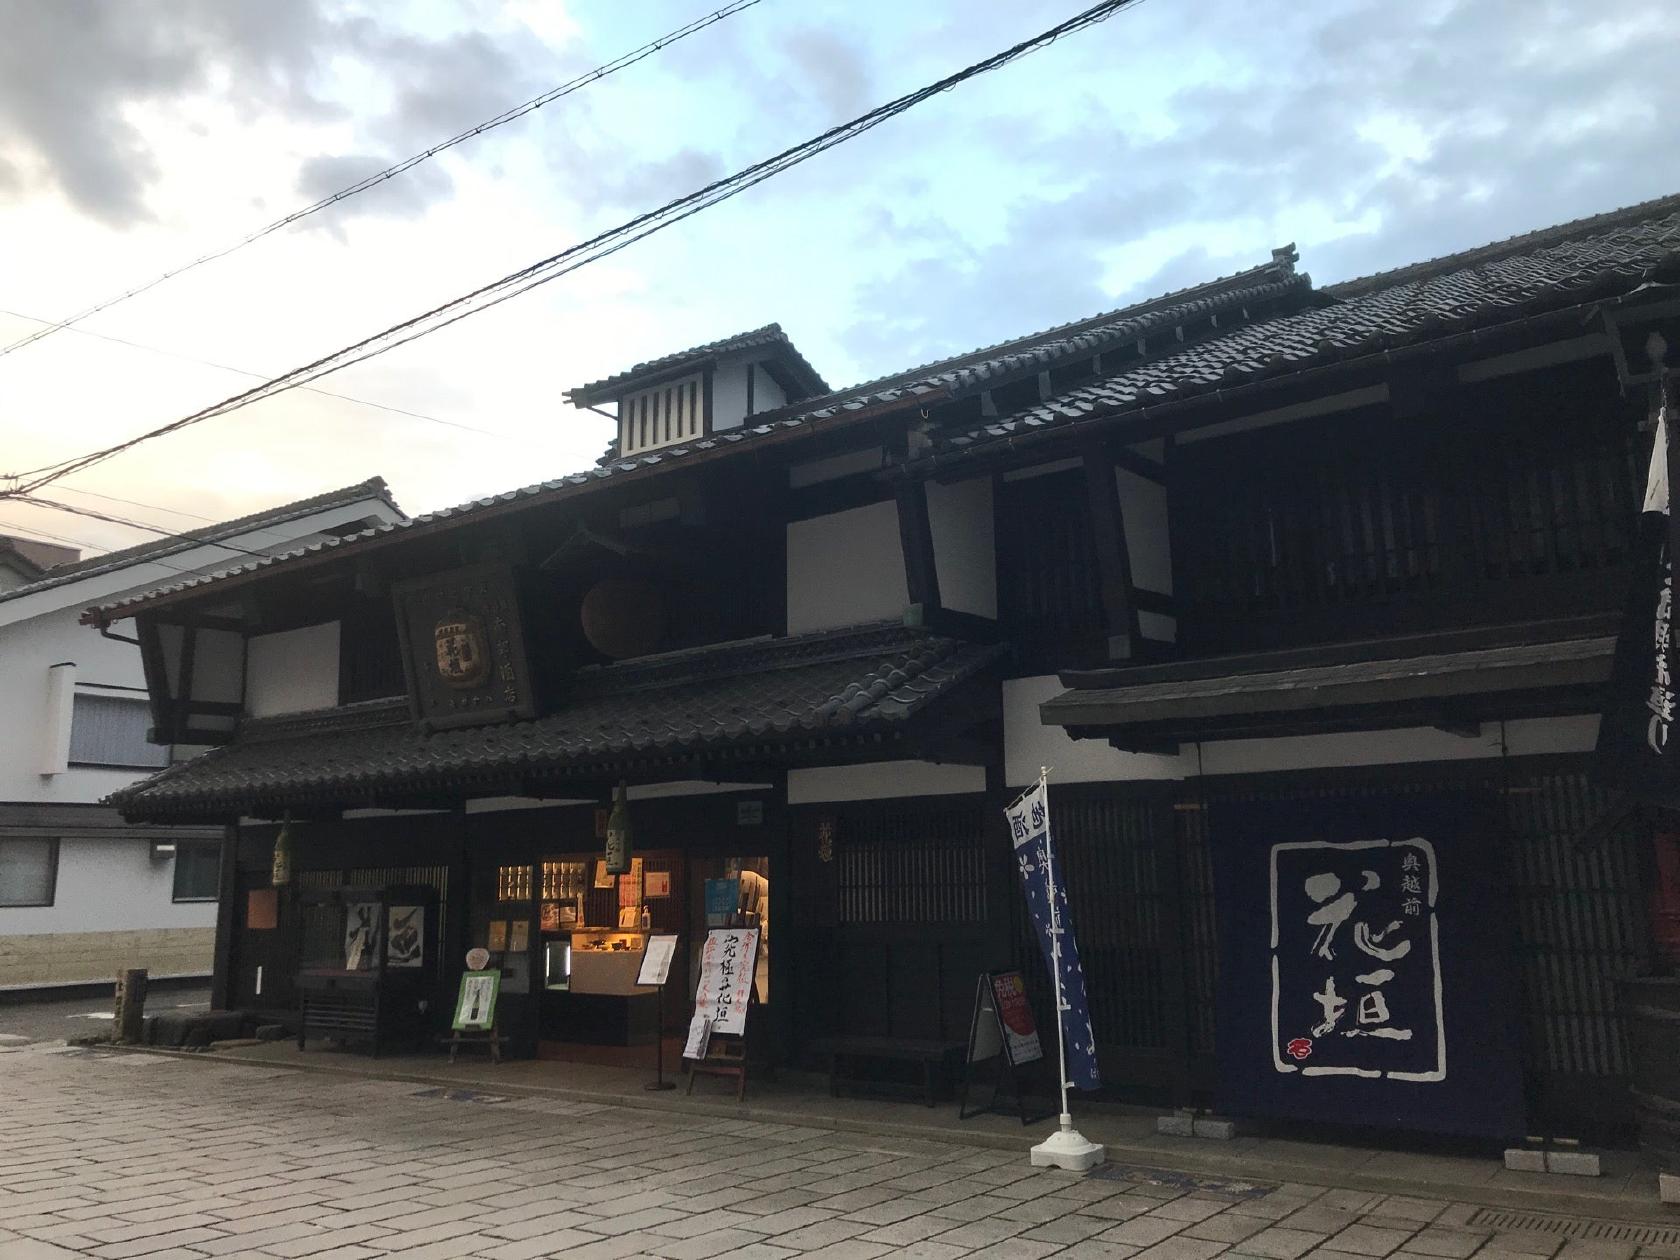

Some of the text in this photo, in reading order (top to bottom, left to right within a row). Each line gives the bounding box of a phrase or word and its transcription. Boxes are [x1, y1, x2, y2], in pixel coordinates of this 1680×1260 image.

[1401, 853, 1423, 916] 奥越前
[713, 934, 740, 1023] 究極の花垣
[1304, 870, 1412, 1040] 花垣
